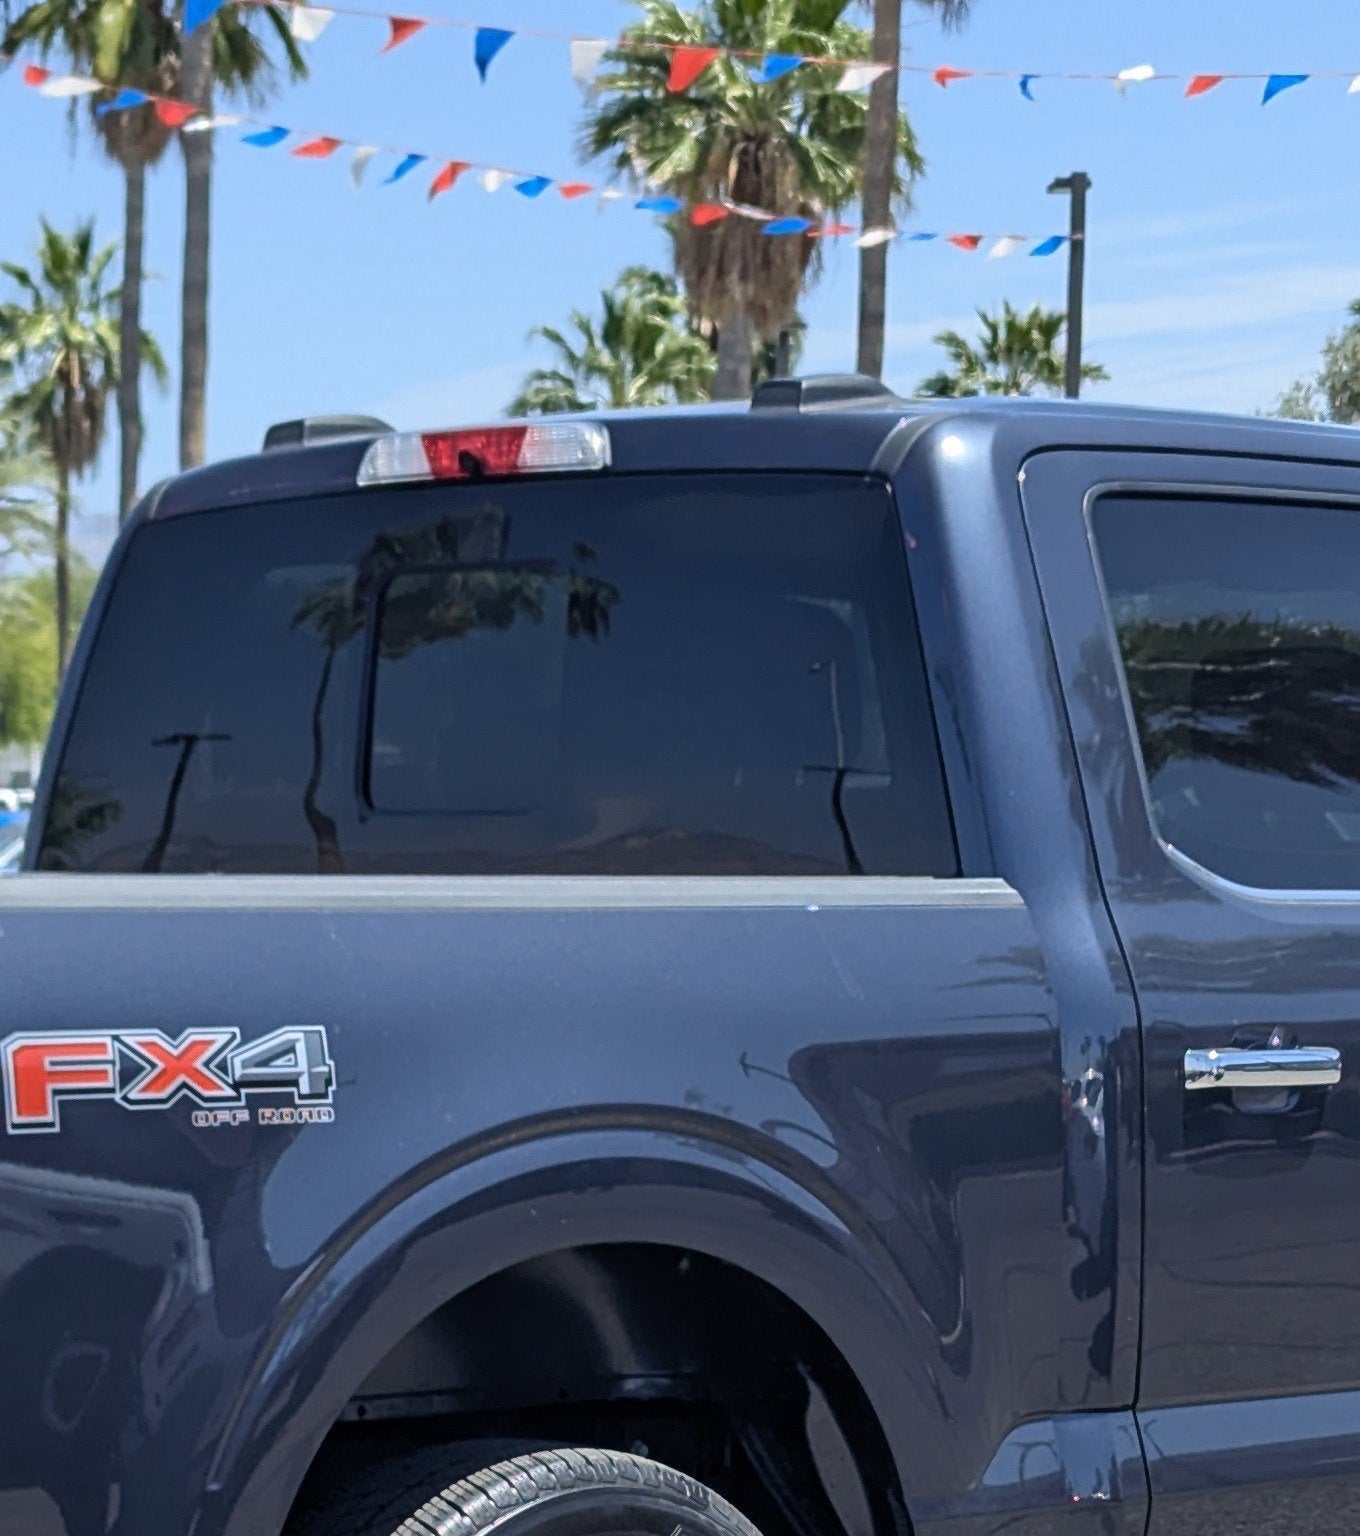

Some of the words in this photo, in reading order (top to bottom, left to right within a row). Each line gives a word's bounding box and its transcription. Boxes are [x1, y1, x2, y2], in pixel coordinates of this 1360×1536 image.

[0, 1025, 336, 1135] FX4
[191, 1107, 251, 1127] OFF
[258, 1105, 336, 1125] ROAD
